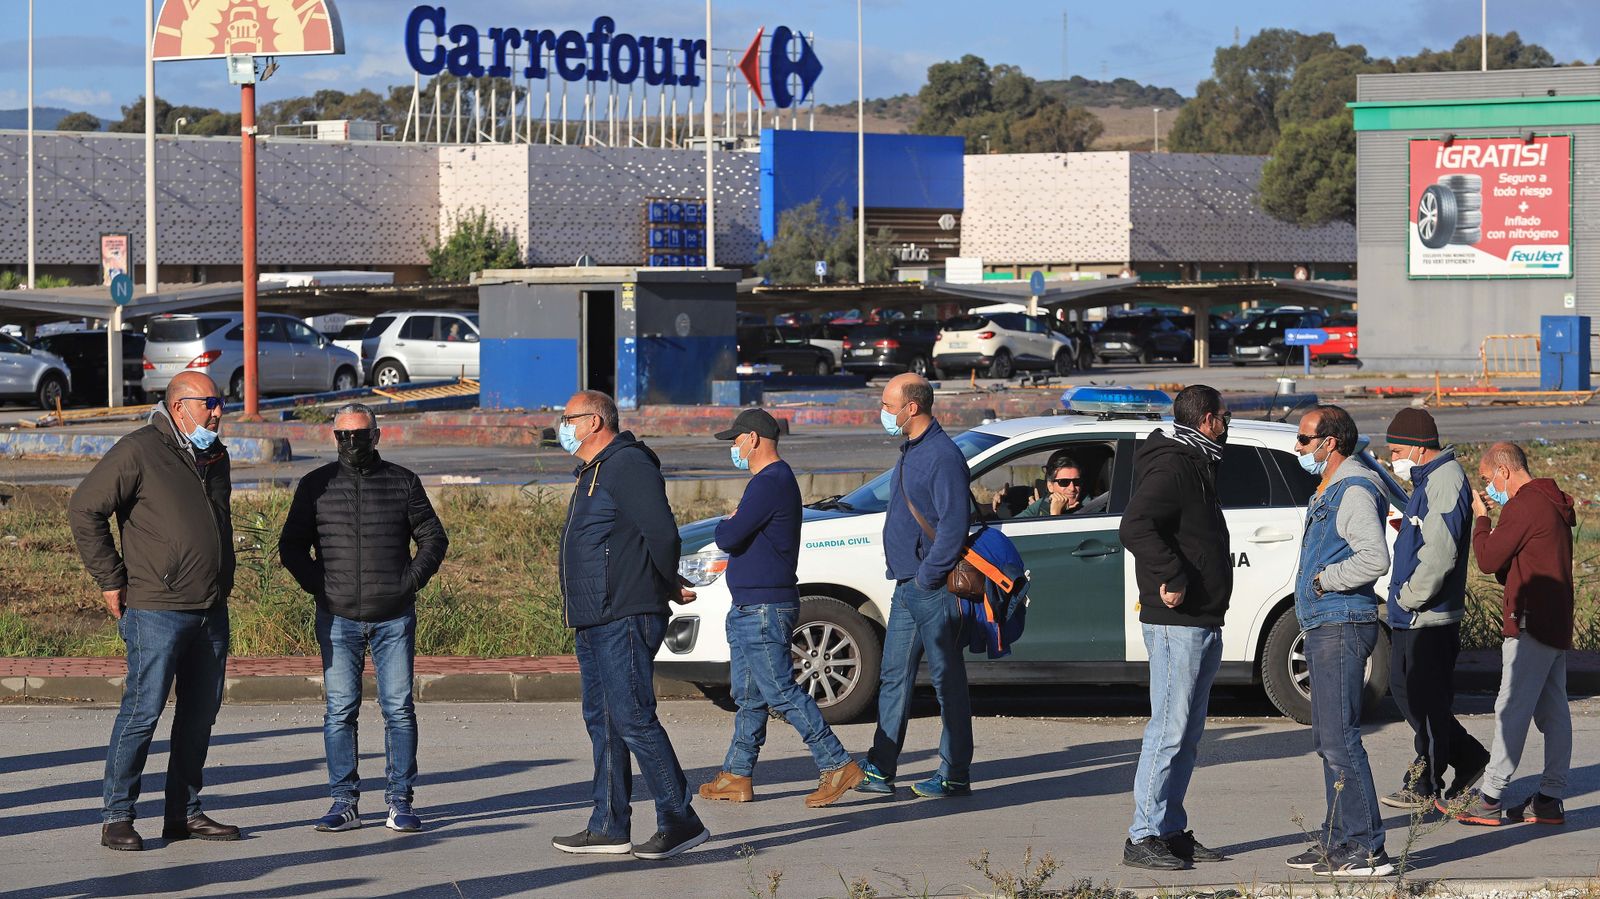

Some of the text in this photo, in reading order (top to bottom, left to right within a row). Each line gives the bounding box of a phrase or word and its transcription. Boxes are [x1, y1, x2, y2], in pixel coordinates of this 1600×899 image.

[405, 5, 707, 86] Carrefour
[1435, 144, 1547, 168] ¡GRATIS!
[1498, 173, 1547, 186] Seguro a
[1493, 187, 1552, 198] todo riesgo
[1504, 216, 1541, 226] Inflado
[1487, 227, 1559, 241] con nitrógeno
[116, 282, 127, 297] N
[805, 537, 871, 549] GUARDIA CIVIL
[1231, 552, 1251, 568] IA
